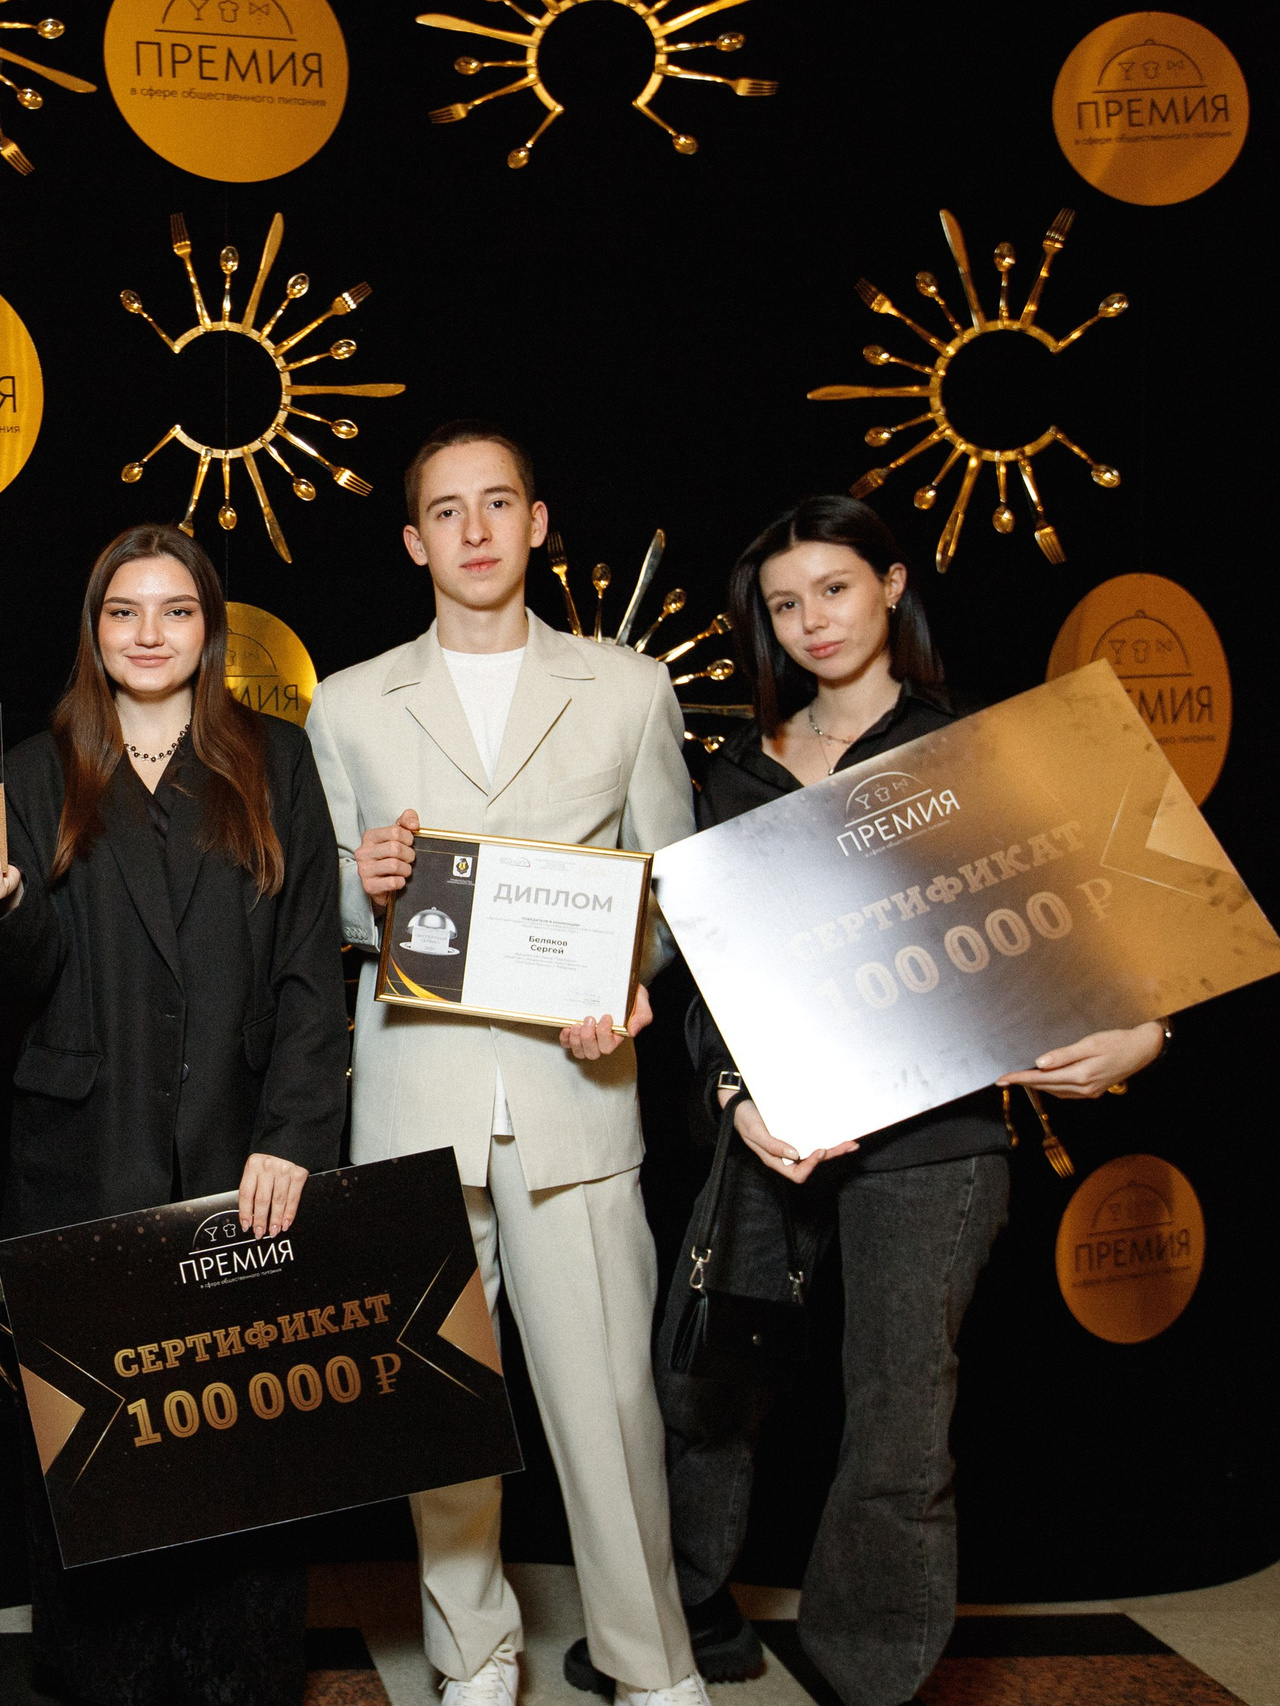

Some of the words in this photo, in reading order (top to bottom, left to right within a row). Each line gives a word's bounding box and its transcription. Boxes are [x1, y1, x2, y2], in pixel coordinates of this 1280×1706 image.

[136, 41, 323, 88] ПРЕМИЯ
[140, 86, 179, 100] сфере
[182, 88, 275, 104] общественного
[277, 96, 327, 107] питания
[1077, 93, 1230, 130] ПРЕМИЯ
[836, 789, 961, 857] ПРЕМИЯ
[493, 883, 613, 913] ДИПЛОМ
[529, 936, 568, 947] Беляков
[531, 944, 565, 955] Сергей
[944, 891, 1073, 975] 000
[179, 1239, 295, 1285] ПРЕМИЯ
[1075, 1229, 1191, 1273] ПРЕМИЯ
[114, 1293, 392, 1378] СЕРТИФИКАТ
[127, 1382, 238, 1448] 100
[248, 1355, 362, 1420] 000
